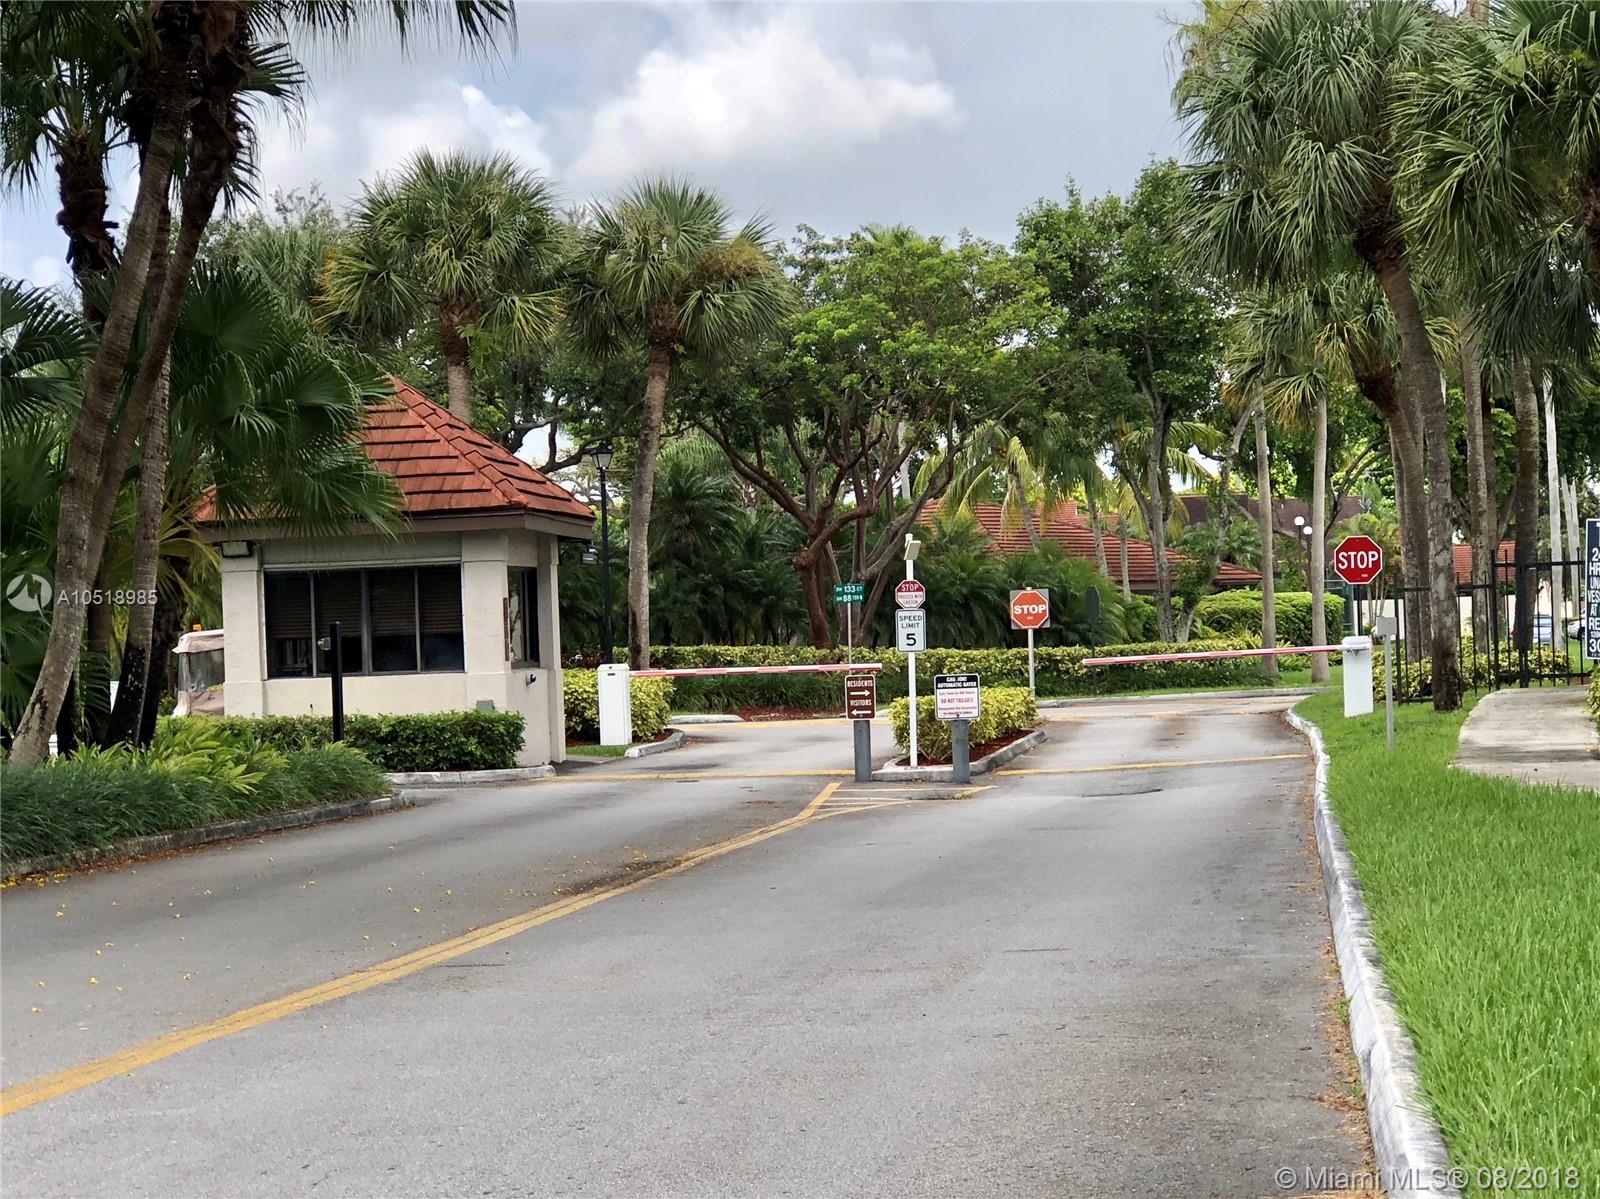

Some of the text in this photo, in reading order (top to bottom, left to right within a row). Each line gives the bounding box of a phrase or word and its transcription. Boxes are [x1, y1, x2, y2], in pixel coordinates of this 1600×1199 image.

[1338, 551, 1379, 569] STOP
[844, 585, 856, 593] 133
[901, 583, 919, 591] STOP
[1014, 604, 1046, 615] STOP
[899, 614, 923, 622] SPEED
[906, 633, 917, 646] 5
